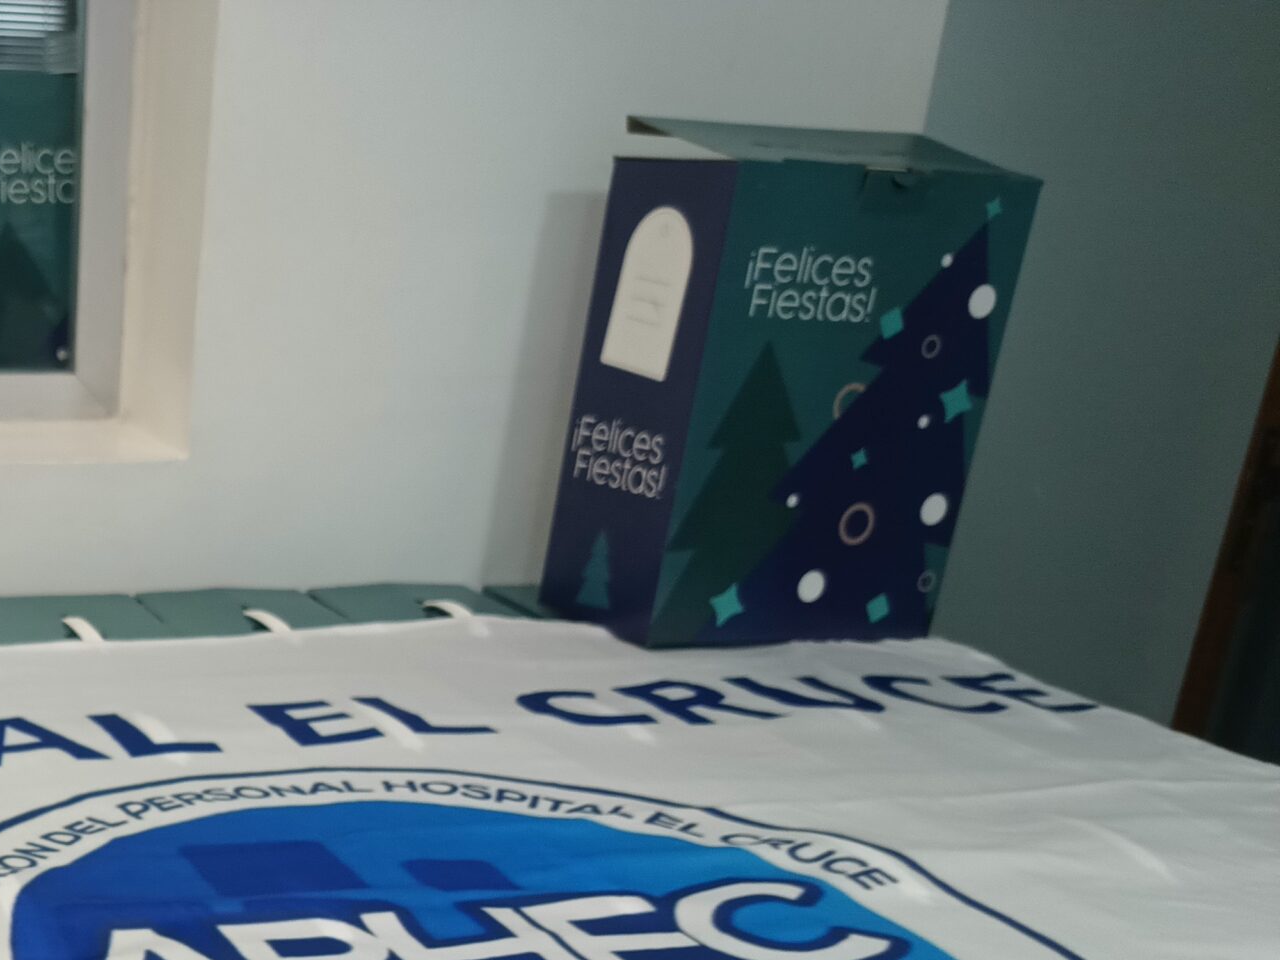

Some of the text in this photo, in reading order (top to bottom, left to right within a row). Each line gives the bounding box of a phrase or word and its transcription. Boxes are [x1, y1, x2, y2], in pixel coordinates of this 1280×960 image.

[744, 246, 874, 290] ¡Felices
[748, 283, 877, 323] Fiestas!
[571, 415, 665, 465] ¡Felices
[573, 449, 667, 499] Fiestas!
[246, 696, 499, 747] EL
[514, 673, 1103, 727] CRUCE
[40, 816, 128, 846] DEL
[116, 778, 376, 824] PERSONAL
[381, 778, 637, 820] HOSPITAL
[642, 810, 708, 840] EL
[720, 830, 900, 892] CRUCE
